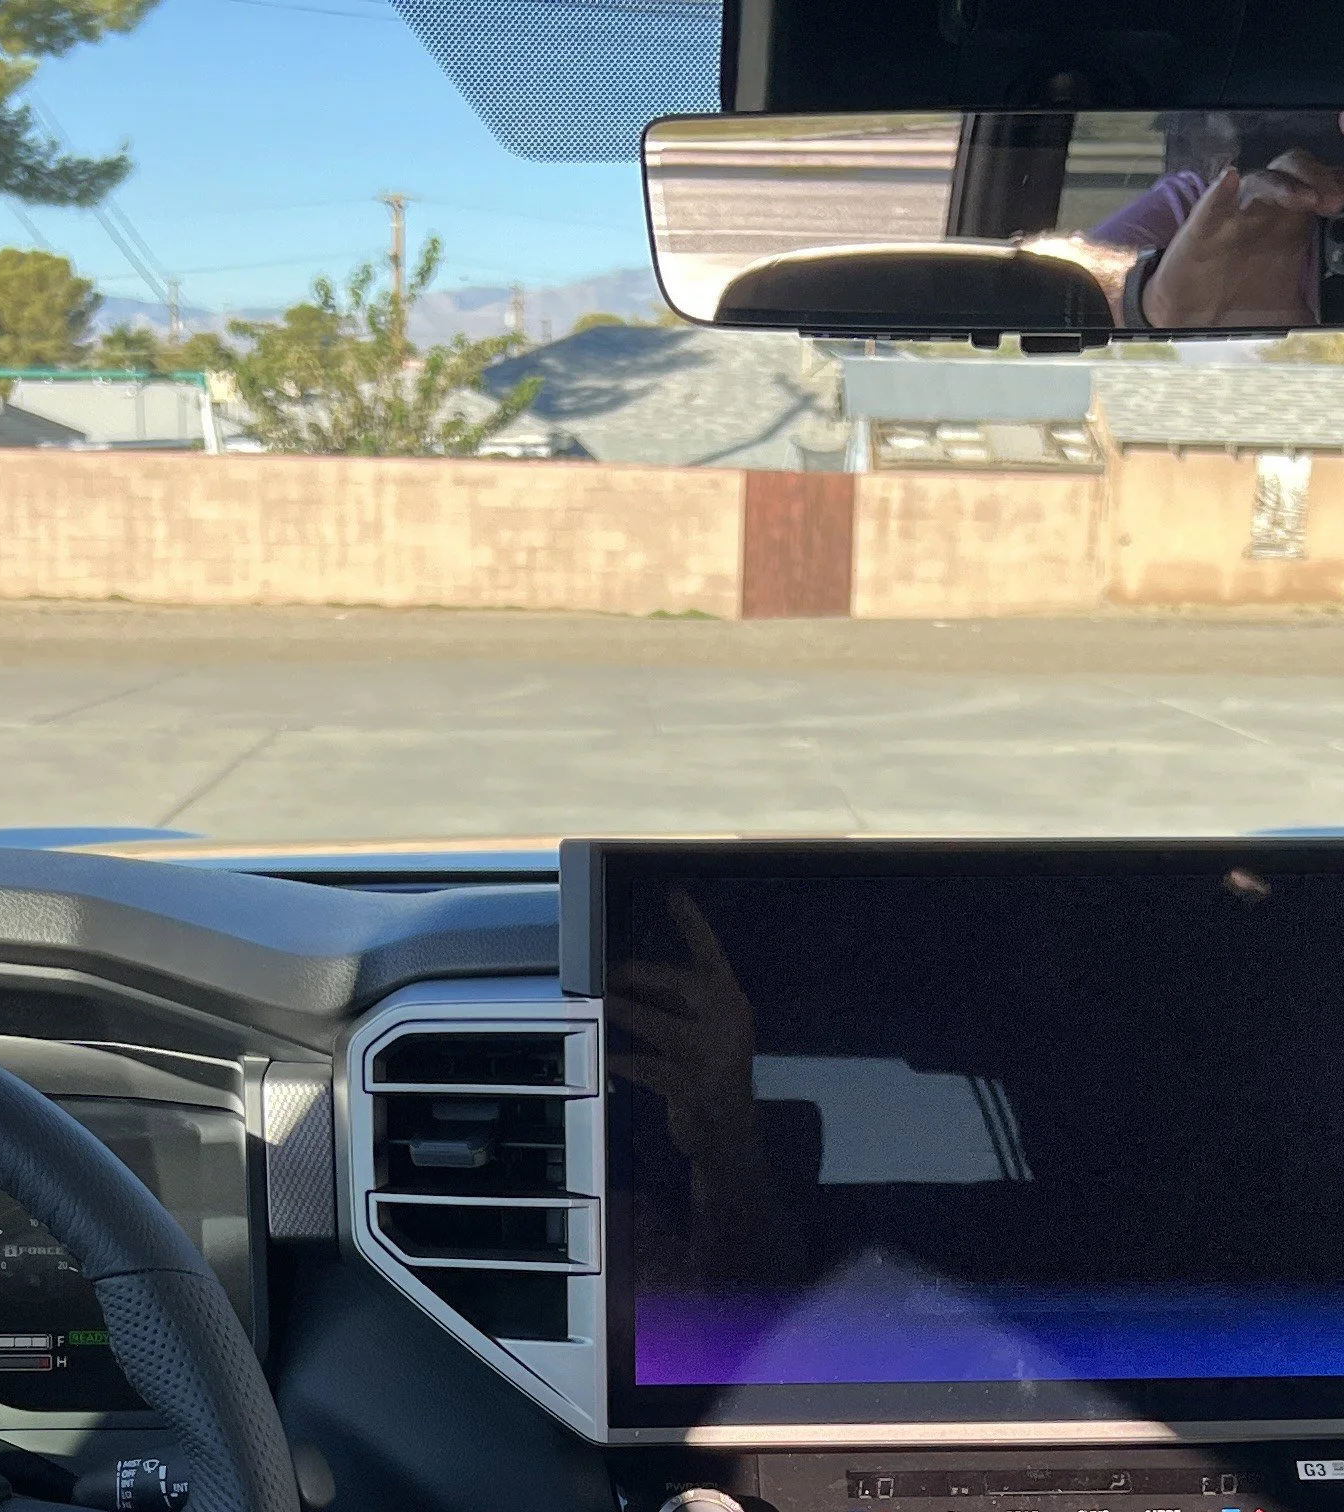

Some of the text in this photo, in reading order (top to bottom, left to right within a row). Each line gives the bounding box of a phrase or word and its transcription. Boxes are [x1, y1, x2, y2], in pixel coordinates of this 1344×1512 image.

[57, 1335, 65, 1347] F
[56, 1356, 67, 1368] H
[1305, 1461, 1327, 1477] G3
[172, 1482, 189, 1493] INT
